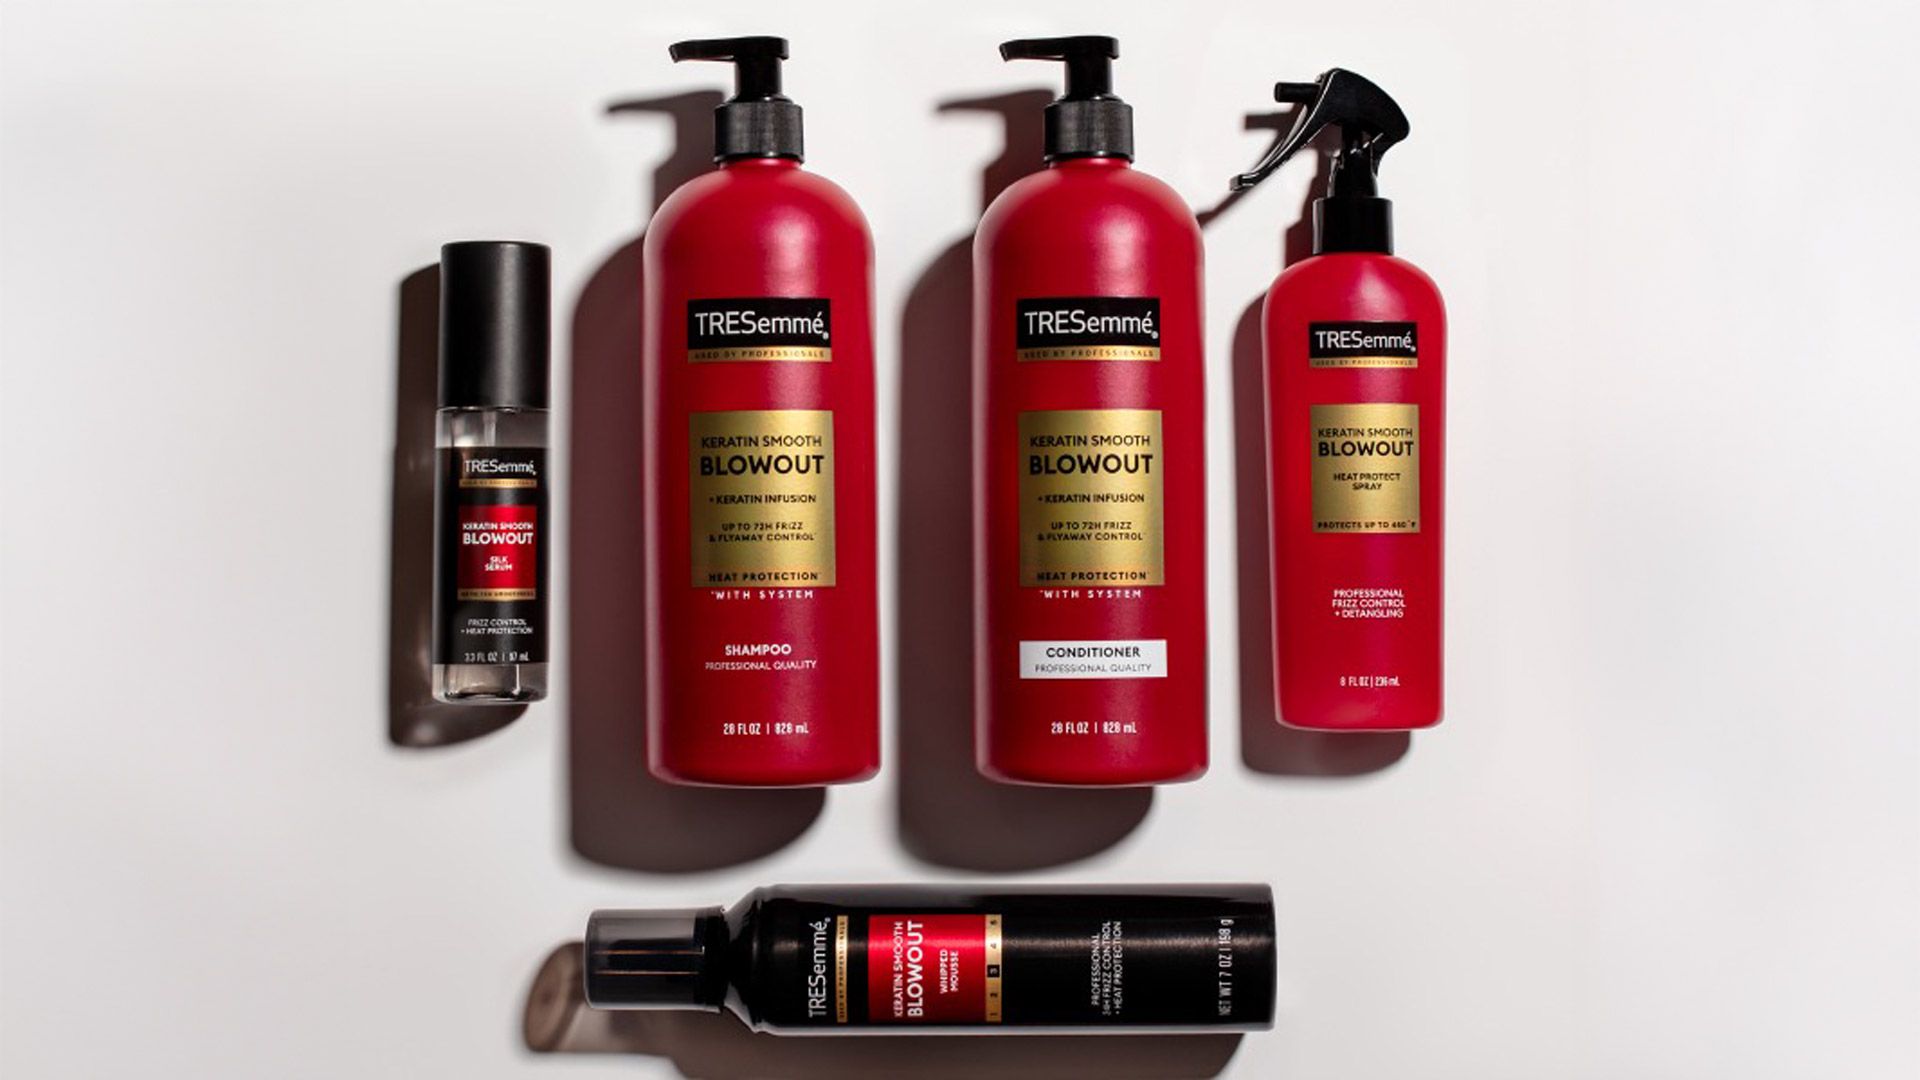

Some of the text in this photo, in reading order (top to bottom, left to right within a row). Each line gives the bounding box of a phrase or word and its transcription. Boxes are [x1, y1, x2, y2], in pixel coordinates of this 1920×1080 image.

[1318, 428, 1413, 437] KERATIN SMOOTH
[702, 435, 822, 448] KERATIN SMOOTH
[1030, 435, 1150, 447] KERATIN SMOOTH
[1318, 441, 1414, 456] BLOWOUT
[700, 455, 824, 476] BLOWOUT
[1030, 454, 1153, 475] BLOWOUT
[1334, 472, 1400, 481] HEAT PROTECT
[1352, 482, 1382, 490] SPRAY
[716, 494, 762, 504] KERATIN
[765, 494, 816, 503] INFUSION
[1045, 494, 1090, 503] KERATIN
[1093, 494, 1145, 503] INFUSION
[722, 522, 803, 531] UP TO 72H FRIZZ
[1051, 522, 1132, 530] UP TO 72H FRIZZ
[1317, 521, 1362, 529] PROTECTS
[463, 532, 533, 544] BLOWOUT
[718, 534, 763, 542] FLYAWAY
[1047, 533, 1091, 541] FLYAWAY
[490, 555, 508, 563] SILK
[485, 563, 513, 571] SERUM
[709, 573, 737, 581] HEAT
[1037, 572, 1066, 581] HEAT
[759, 590, 814, 600] SYSTEM
[1088, 589, 1142, 599] SYSTEM
[1334, 589, 1404, 598] PROFESSIONAL
[1332, 599, 1406, 608] FRIZZ CONTROL
[1342, 609, 1404, 618] DETANGLING
[725, 644, 792, 656] SHAMPOO
[1046, 647, 1141, 658] CONDITIONER
[705, 660, 817, 671] PROFESSIONAL QUALITY
[1035, 663, 1152, 673] PROFESSIONAL QUALITY
[723, 722, 735, 735] 28
[738, 722, 748, 735] FL
[749, 722, 760, 735] OZ
[775, 722, 793, 734] 828
[795, 722, 809, 734] mL
[1051, 721, 1063, 734] 28
[1065, 721, 1075, 734] FL
[1077, 721, 1089, 734] OZ
[1103, 721, 1120, 734] 828
[1123, 721, 1137, 733] mL
[1218, 928, 1231, 944] 198
[1102, 921, 1111, 970] CONTROL
[1113, 921, 1122, 985] PROTECTION
[1219, 954, 1232, 967] OZ
[894, 922, 903, 1017] KERATIN SMOOTH
[907, 921, 923, 1017] BLOWOUT
[940, 949, 948, 994] WHIPPED
[950, 950, 958, 992] MOUSSE
[1092, 933, 1100, 1005] PROFESSIONAL
[1102, 972, 1111, 997] FRIZZ
[1219, 981, 1232, 997] WT
[1113, 987, 1122, 1009] HEAT
[1218, 1000, 1231, 1016] NET
